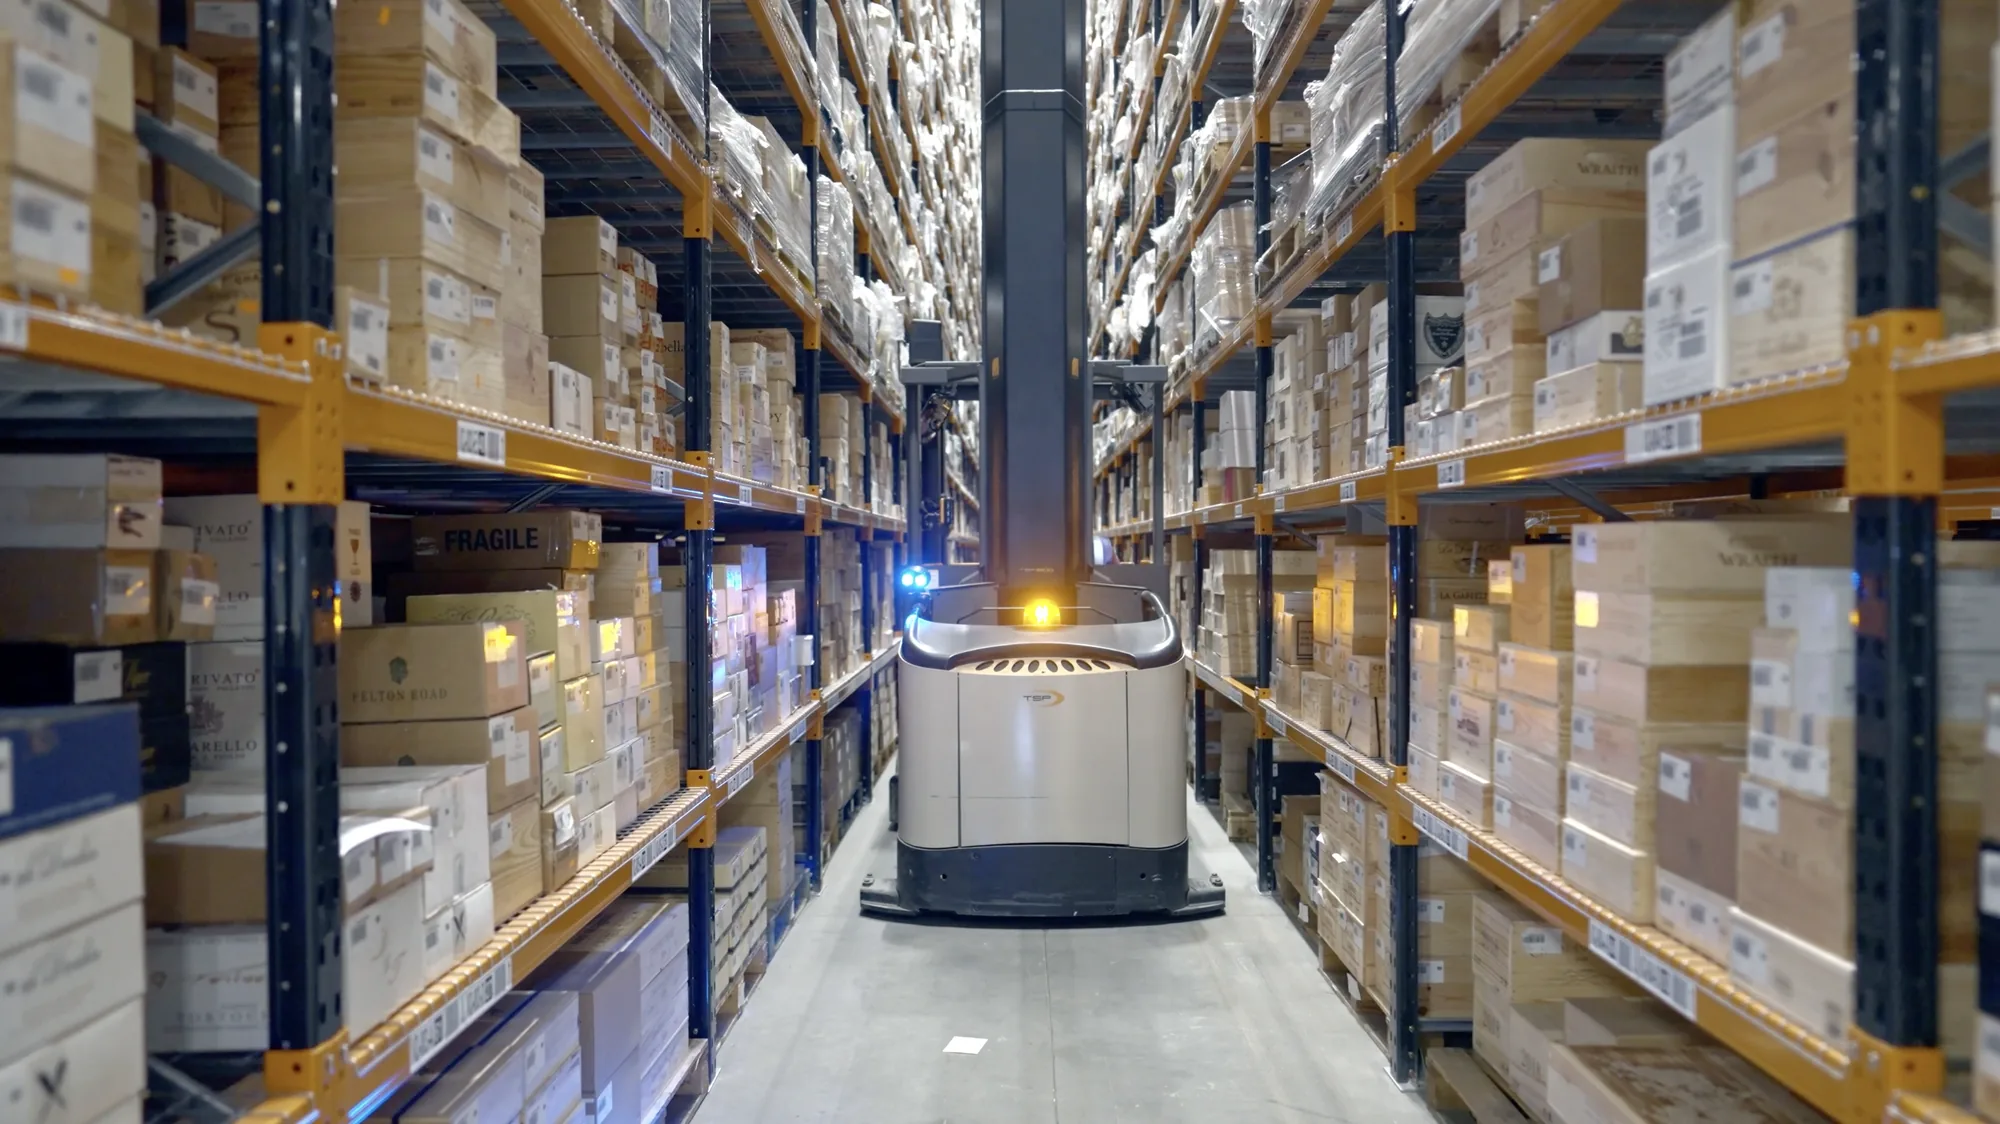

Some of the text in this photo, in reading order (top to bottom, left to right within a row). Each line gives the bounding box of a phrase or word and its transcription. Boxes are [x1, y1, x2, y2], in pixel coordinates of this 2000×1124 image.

[444, 527, 539, 552] FRAGILE
[352, 688, 448, 703] FELTON ROAD
